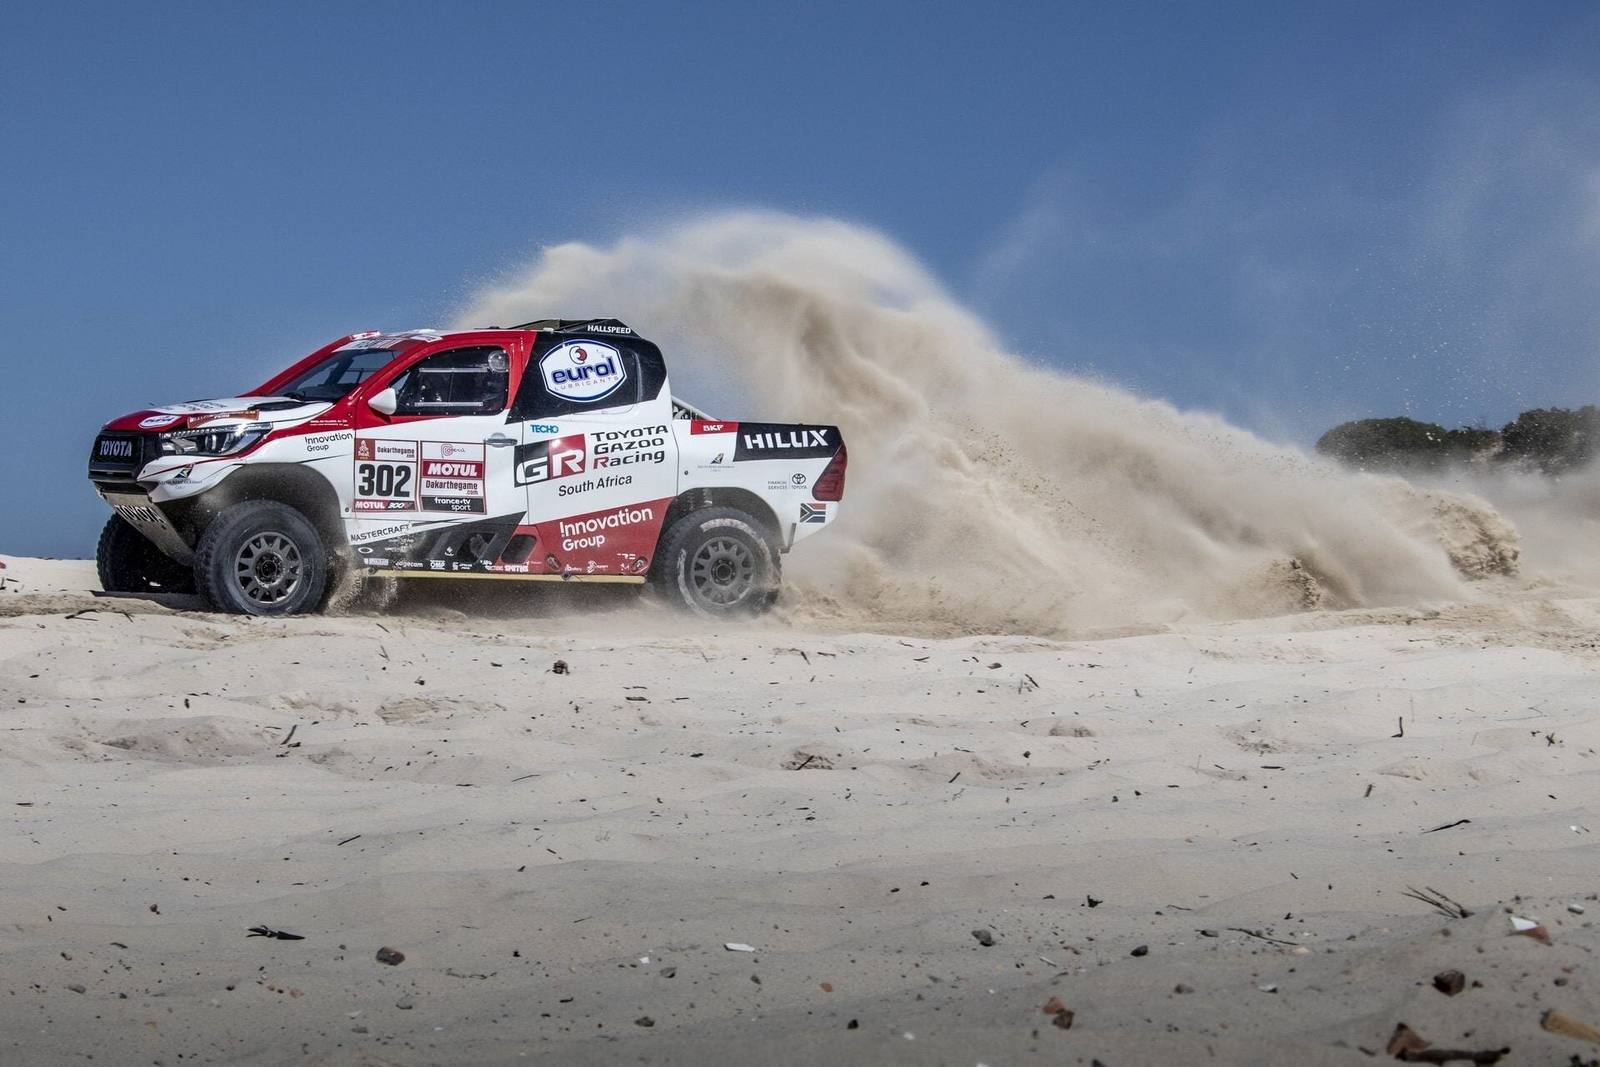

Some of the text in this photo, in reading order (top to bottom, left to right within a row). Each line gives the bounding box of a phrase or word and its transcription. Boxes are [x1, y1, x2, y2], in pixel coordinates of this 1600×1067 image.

[587, 325, 632, 334] HALLSPEED
[552, 356, 617, 384] eurol
[554, 376, 619, 390] LUBRICANTS
[590, 425, 669, 442] TOYOTA
[744, 429, 828, 449] HILUX
[99, 440, 132, 457] TOYOTA
[306, 444, 330, 452] Group
[377, 446, 415, 454] Dakarthegame
[593, 437, 665, 456] GAZOO
[516, 449, 583, 484] GR
[593, 450, 665, 470] Racing
[427, 462, 478, 477] MOTUL
[358, 463, 411, 498] 302
[425, 480, 478, 491] Dakarthegame
[558, 474, 632, 497] South Africa
[355, 501, 386, 509] MOTUL
[451, 503, 472, 511] sport
[562, 534, 606, 551] Group
